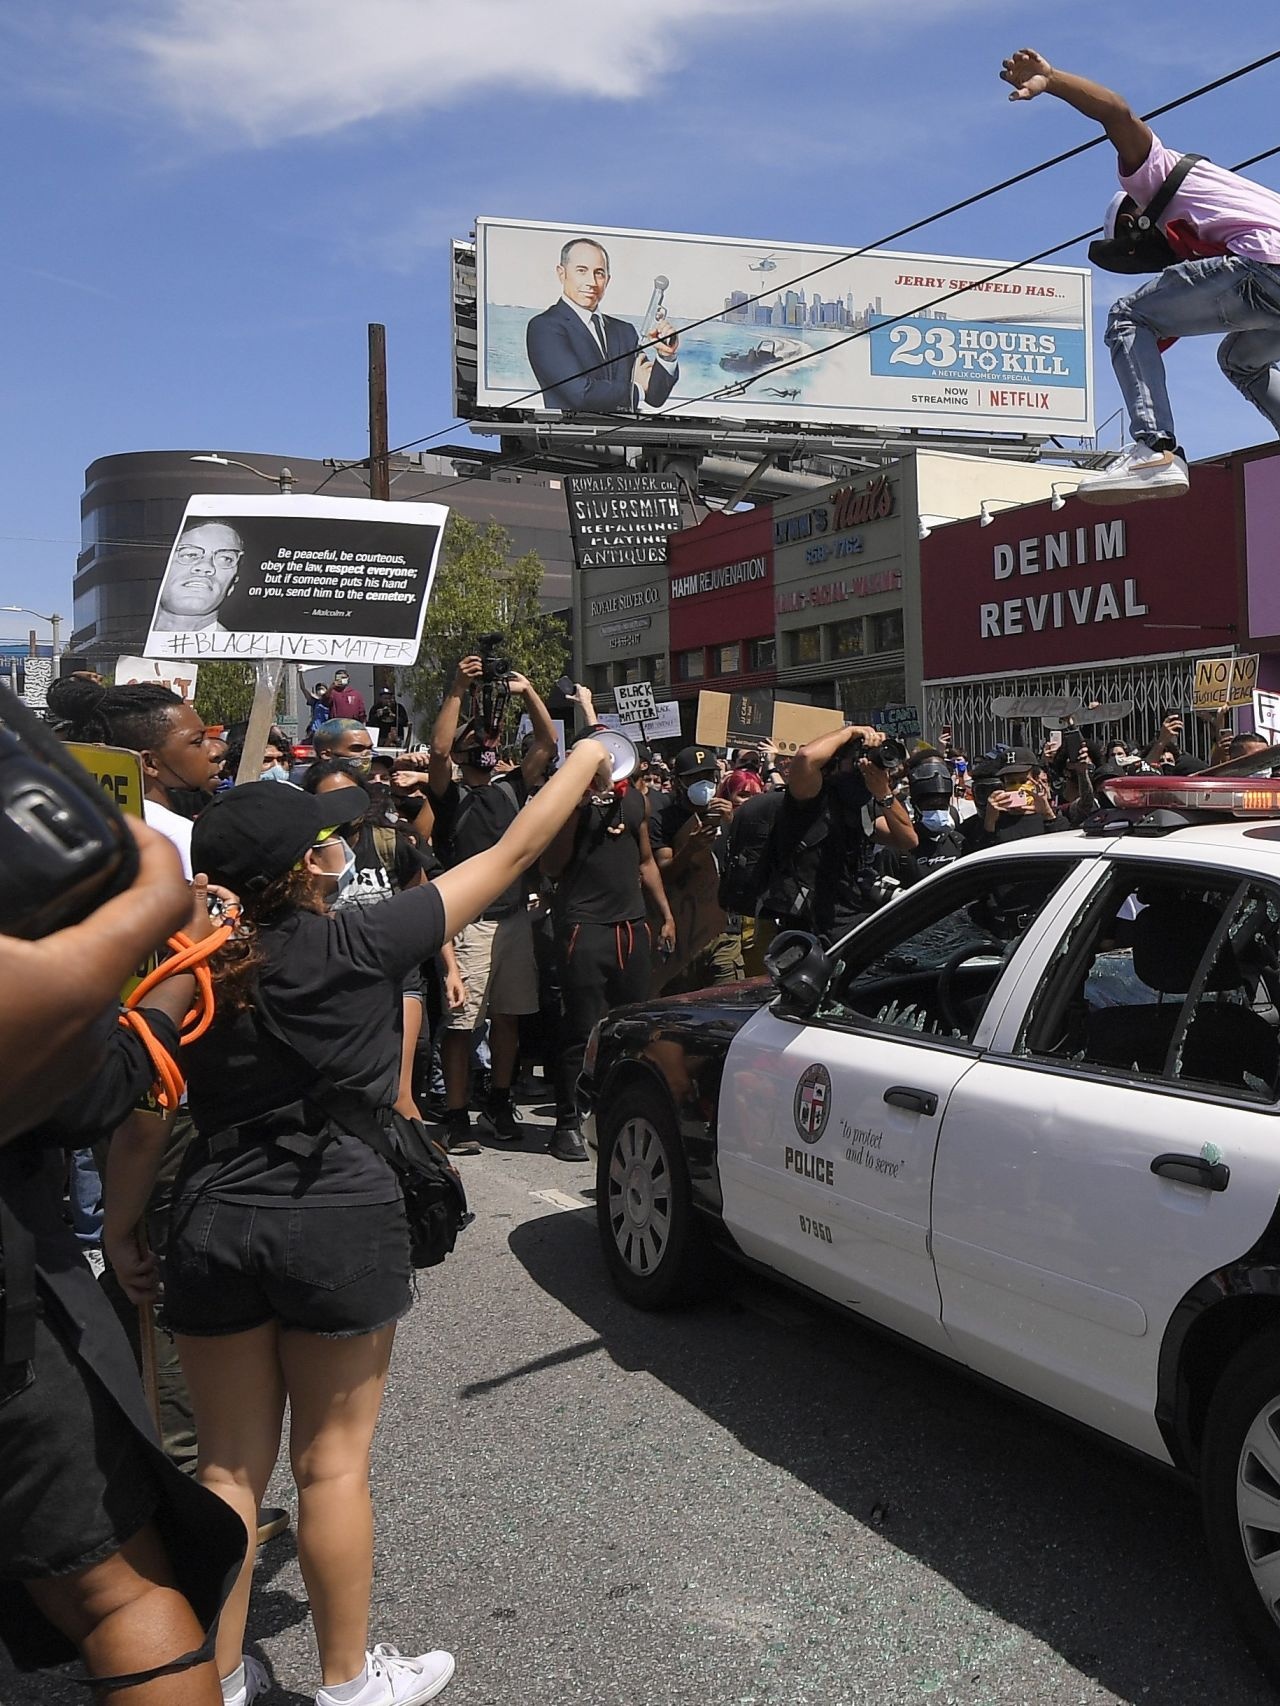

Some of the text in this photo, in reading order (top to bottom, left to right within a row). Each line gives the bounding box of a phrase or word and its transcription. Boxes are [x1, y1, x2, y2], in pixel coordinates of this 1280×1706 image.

[894, 275, 1065, 298] JERRY SEINFELD HAS...
[889, 325, 1056, 368] 23 HOURS
[957, 350, 1069, 376] TO KILL
[938, 370, 969, 378] NETFLIX
[970, 372, 1001, 380] COMEDY
[1002, 374, 1032, 382] SPECIAL
[911, 395, 969, 406] STREAMING
[944, 388, 969, 396] NOW
[990, 390, 1049, 410] NETFLIX
[575, 498, 679, 519] SILVERSMITH
[277, 548, 406, 565] Be peaceful, be courteous,
[583, 547, 667, 565] ANTIQUES
[993, 519, 1126, 580] DENIM
[261, 561, 418, 579] obey the law, respect everyone;
[671, 557, 766, 599] HAHM REJUVENATION
[264, 573, 408, 589] but if someone puts his hand
[249, 587, 417, 604] on you, send him to the cemetery.
[591, 599, 618, 616] ROYALE
[618, 592, 644, 611] SILVER
[312, 608, 345, 617] Malcolm
[980, 578, 1149, 638] REVIVAL
[168, 632, 413, 660] #BLACKLIVESMATTER
[1199, 663, 1227, 685] NO
[1232, 658, 1256, 681] NO
[619, 685, 652, 698] BLACK
[1193, 688, 1226, 705] JUSTICE
[619, 698, 650, 710] LIVES
[619, 708, 656, 722] MATTER
[695, 751, 706, 763] P
[1006, 752, 1016, 764] H
[851, 1128, 884, 1149] protect
[785, 1146, 834, 1186] POLICE
[845, 1147, 863, 1165] and
[865, 1150, 874, 1169] to
[799, 1214, 833, 1244] 87950
